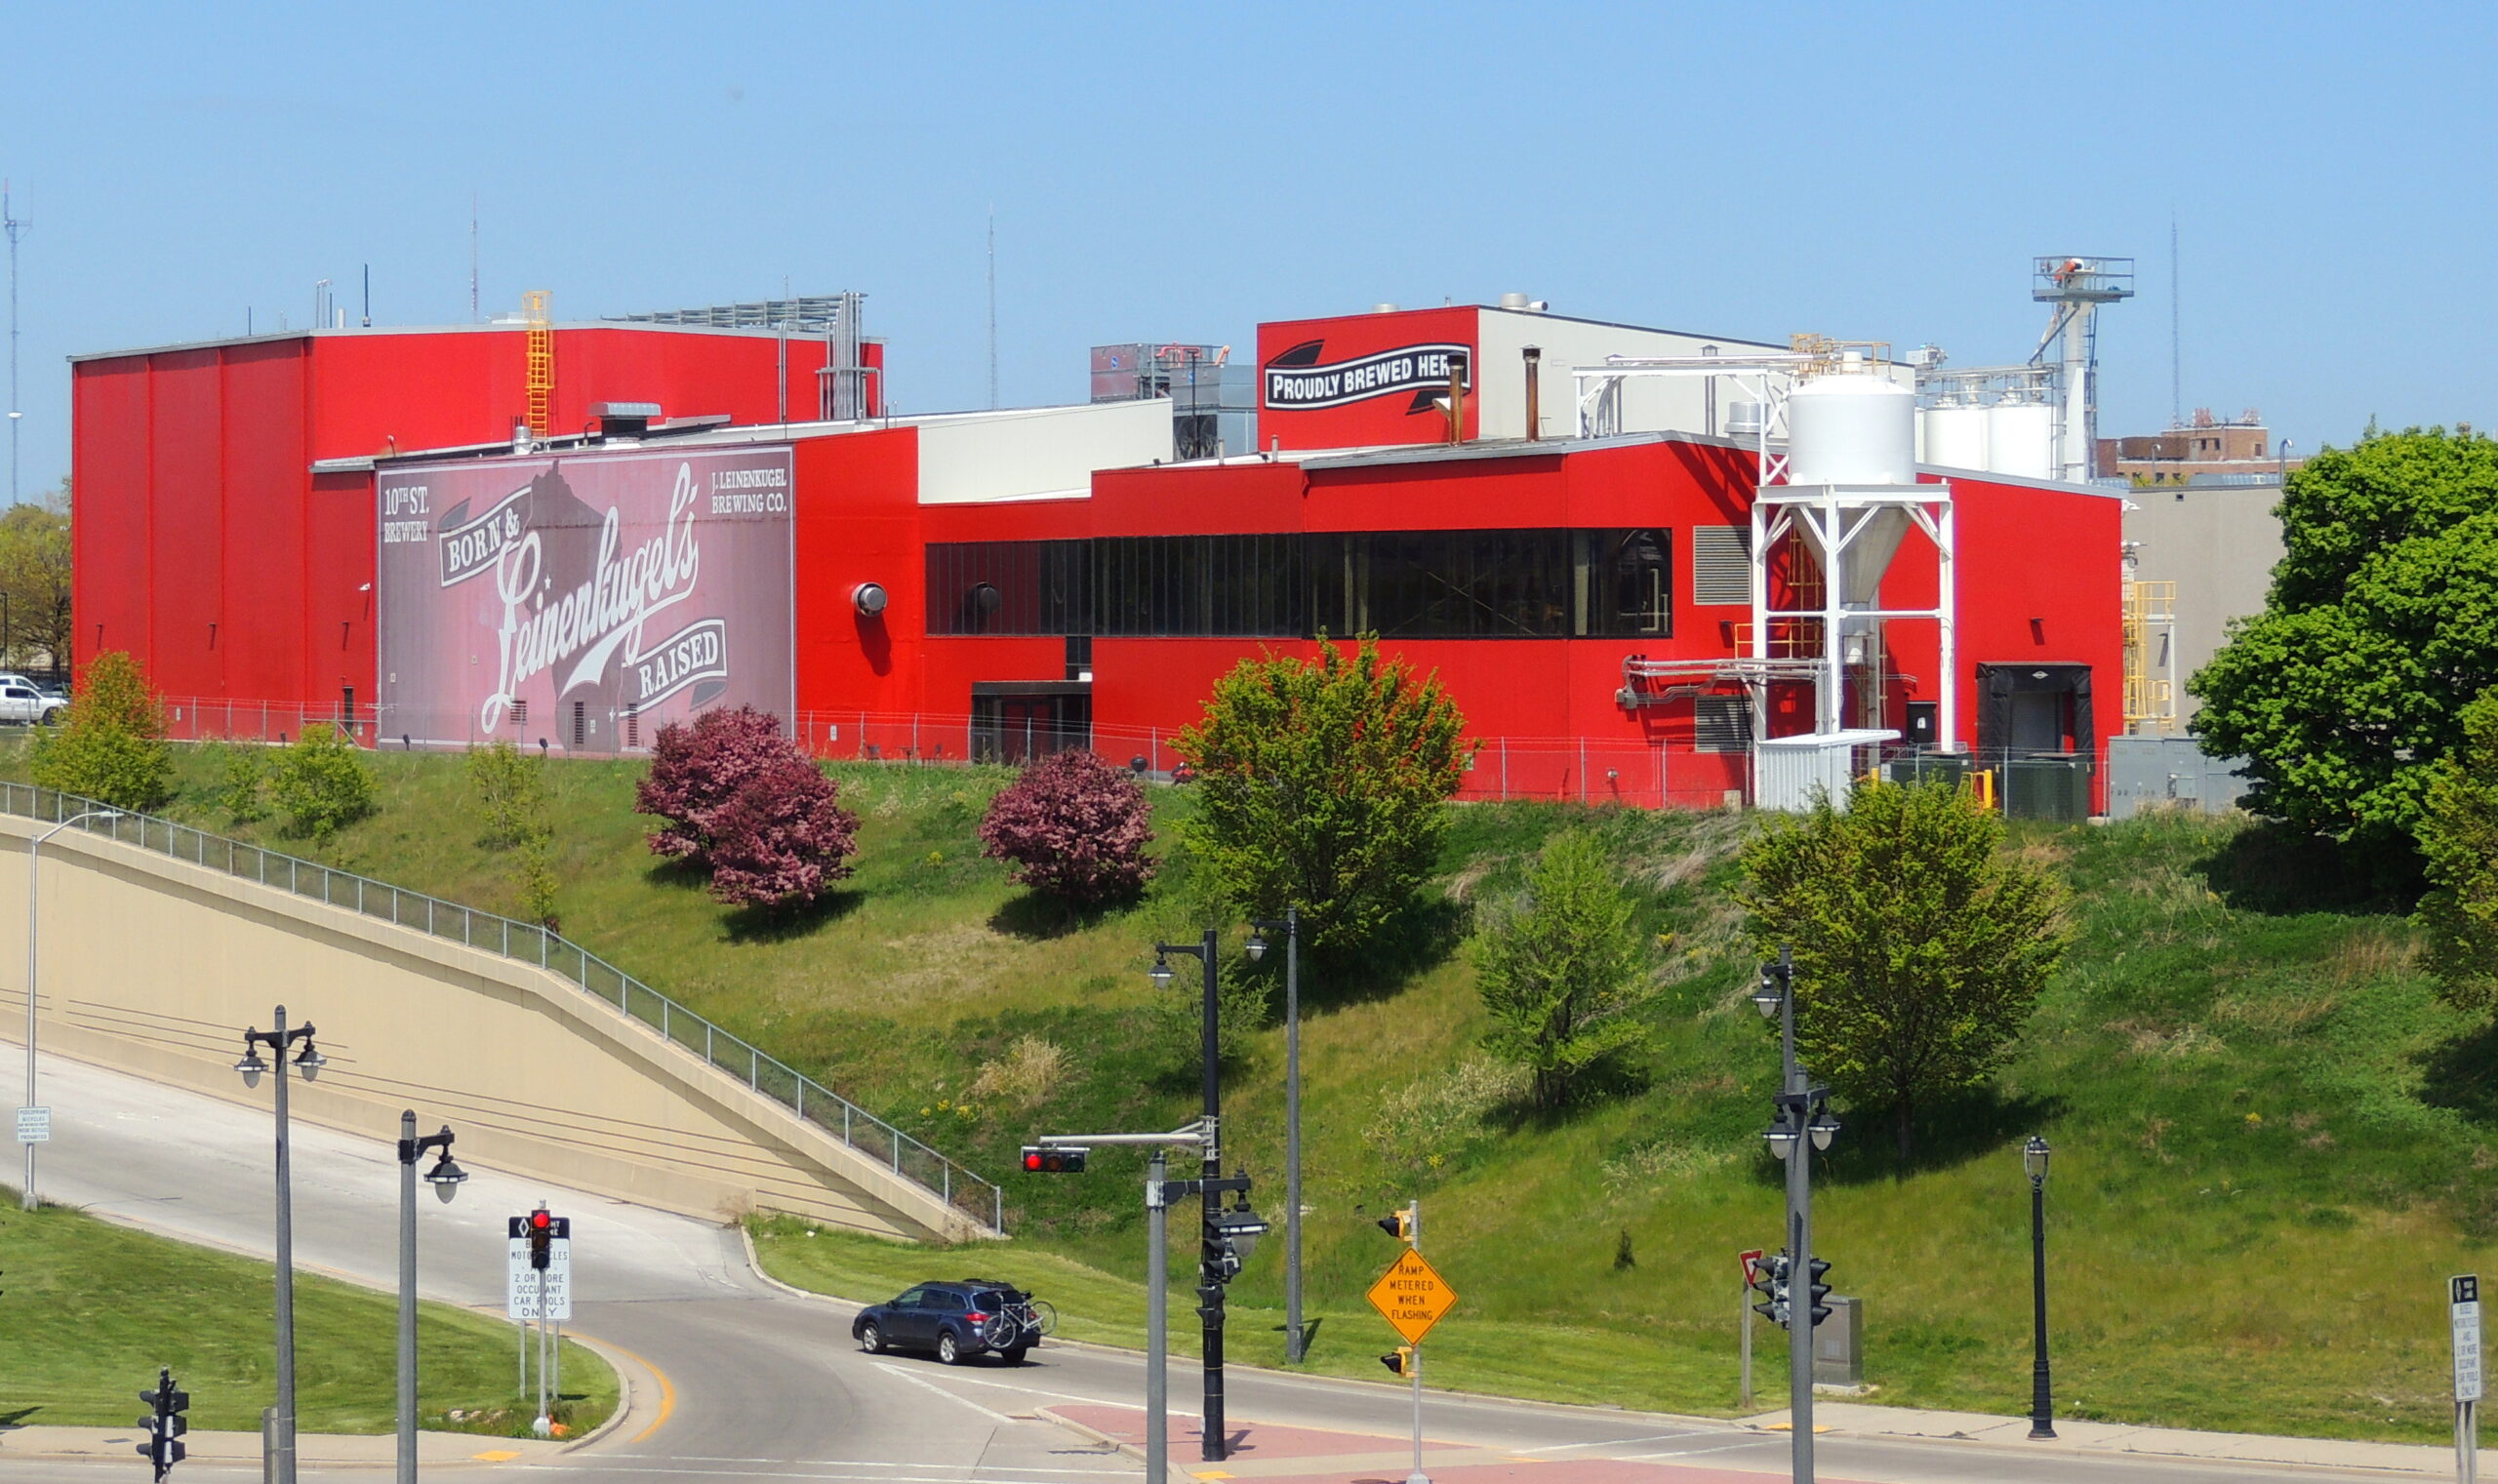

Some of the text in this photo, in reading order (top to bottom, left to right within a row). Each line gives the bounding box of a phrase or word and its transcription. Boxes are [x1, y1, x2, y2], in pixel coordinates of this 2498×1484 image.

[1272, 354, 1451, 400] PROUDLY BREWED HER
[720, 468, 787, 490] LEINENKUGEL
[409, 487, 430, 514] ST.
[711, 492, 787, 514] BREWING CO.
[383, 521, 428, 543] BREWERY
[448, 507, 520, 573] BORN &
[482, 461, 700, 734] Leinenkugel's
[639, 630, 718, 700] RAISED
[514, 1273, 564, 1283] 2 OR ORE
[1398, 1265, 1425, 1275] RAMP
[516, 1284, 562, 1294] OCCUANT
[1390, 1280, 1434, 1291] METERED
[513, 1296, 532, 1305] CAR
[1397, 1295, 1425, 1305] WHEN
[521, 1307, 558, 1317] ONY
[1391, 1309, 1433, 1321] FLASHING
